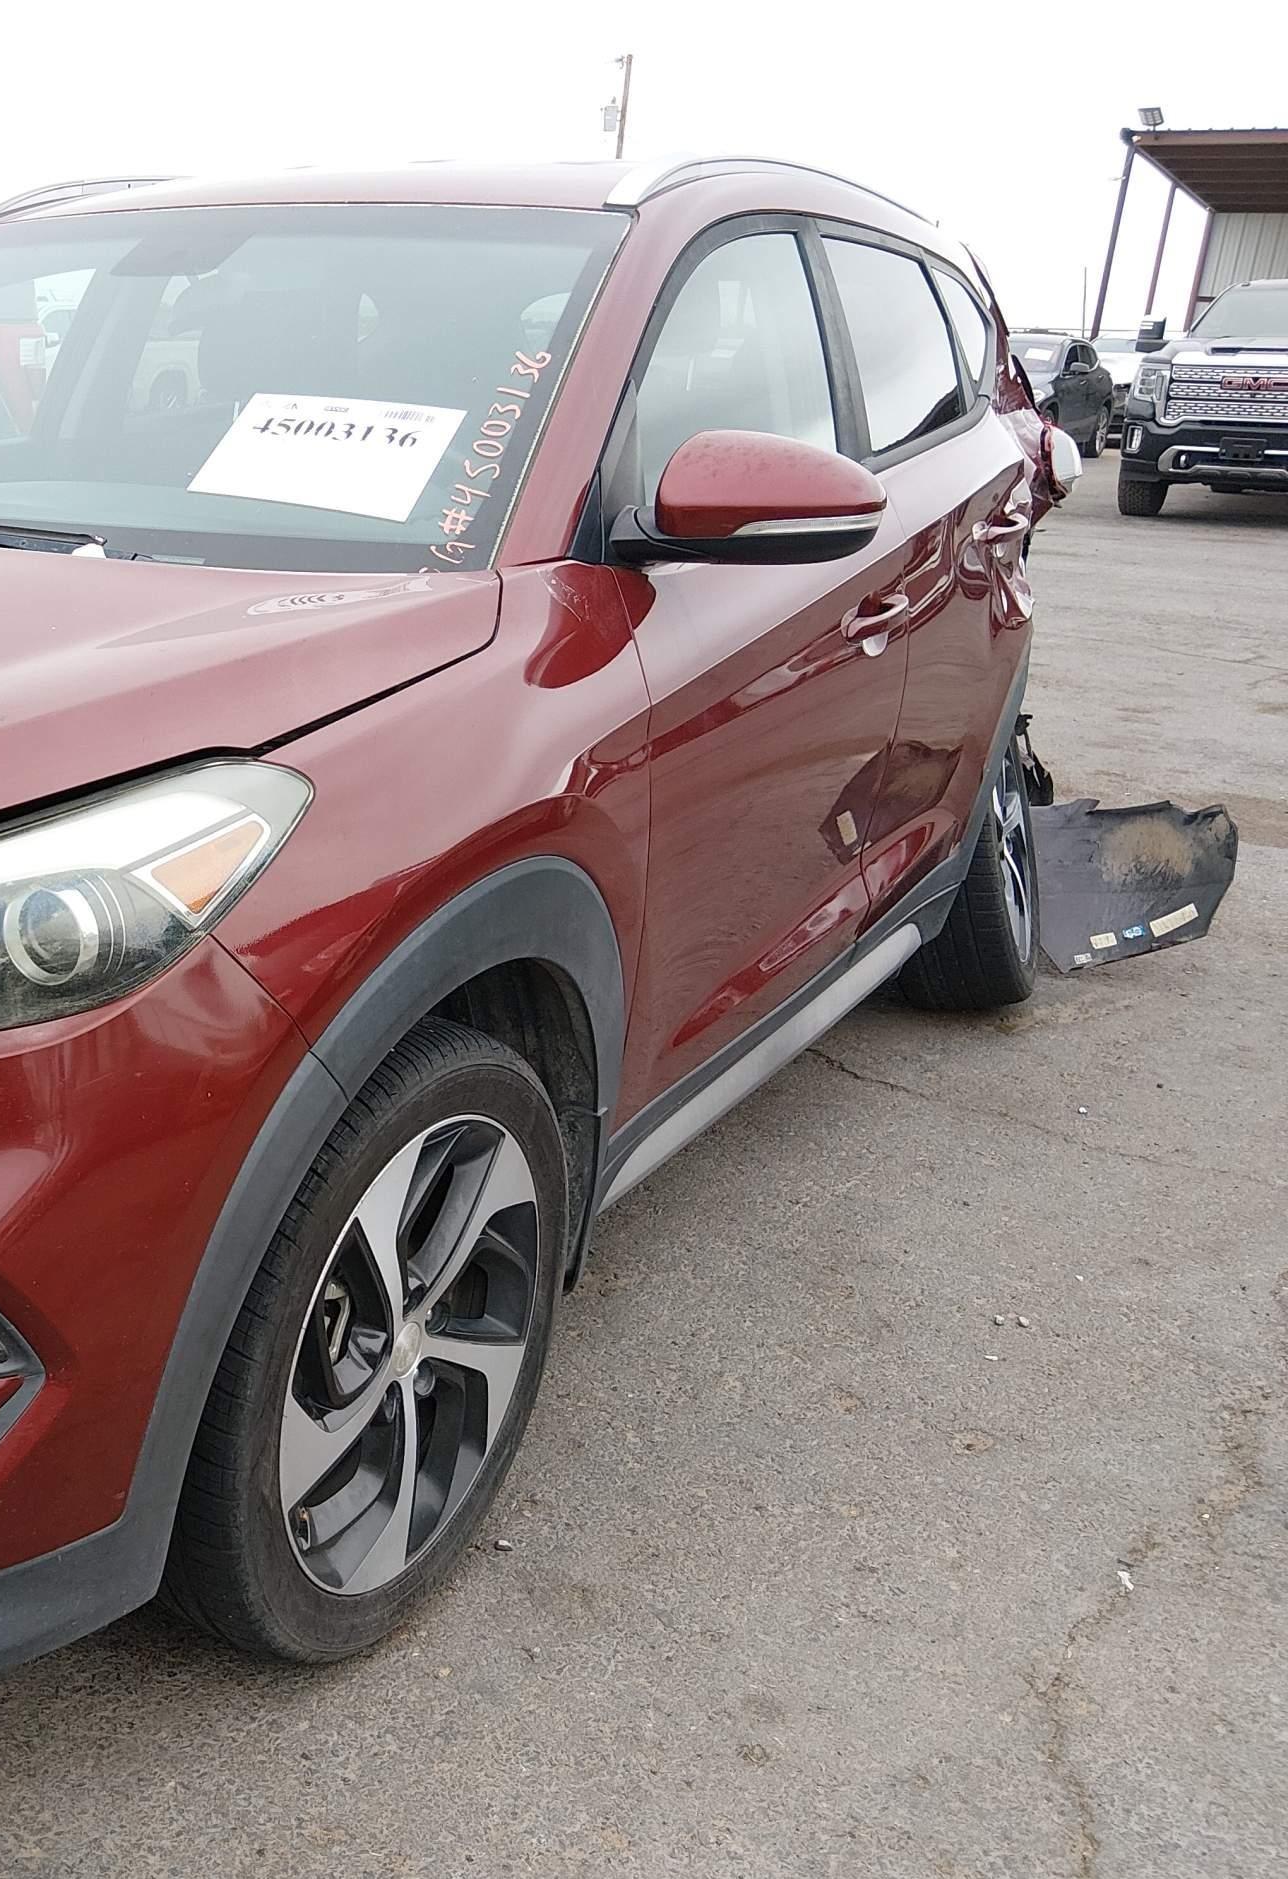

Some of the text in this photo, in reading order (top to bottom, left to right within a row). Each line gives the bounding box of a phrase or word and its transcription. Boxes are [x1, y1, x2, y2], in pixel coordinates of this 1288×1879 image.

[1221, 377, 1288, 390] GMC
[253, 417, 423, 447] 45003136
[418, 351, 552, 573] G#45003136
